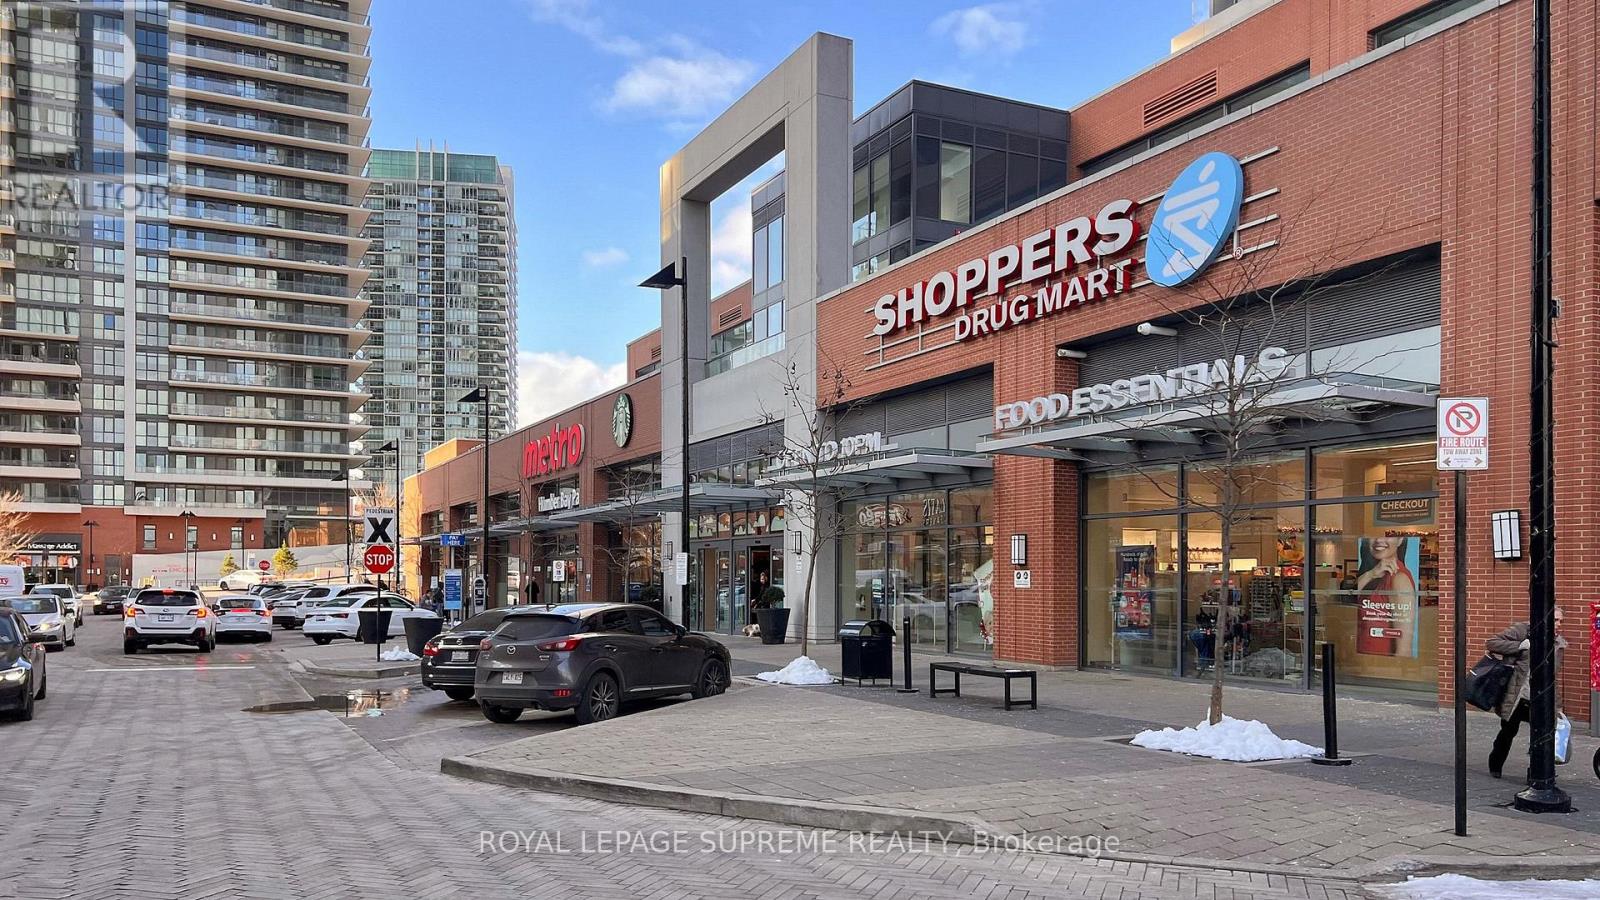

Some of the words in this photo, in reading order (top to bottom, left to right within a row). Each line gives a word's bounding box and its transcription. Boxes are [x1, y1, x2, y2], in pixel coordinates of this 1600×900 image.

[873, 199, 1138, 336] SHOPPERS
[955, 295, 1030, 341] DRUG
[1037, 258, 1137, 316] MART
[996, 394, 1070, 431] FOOD
[1072, 347, 1290, 417] ESSENTIALS
[523, 423, 584, 479] metro
[837, 431, 882, 459] 10PM
[1441, 437, 1459, 447] FIRE
[1460, 437, 1485, 447] ROUTE
[1381, 499, 1430, 510] CHECKOUT
[366, 517, 394, 543] X
[366, 554, 393, 566] STOP
[1362, 599, 1396, 610] Sleeves
[1397, 601, 1412, 613] up!
